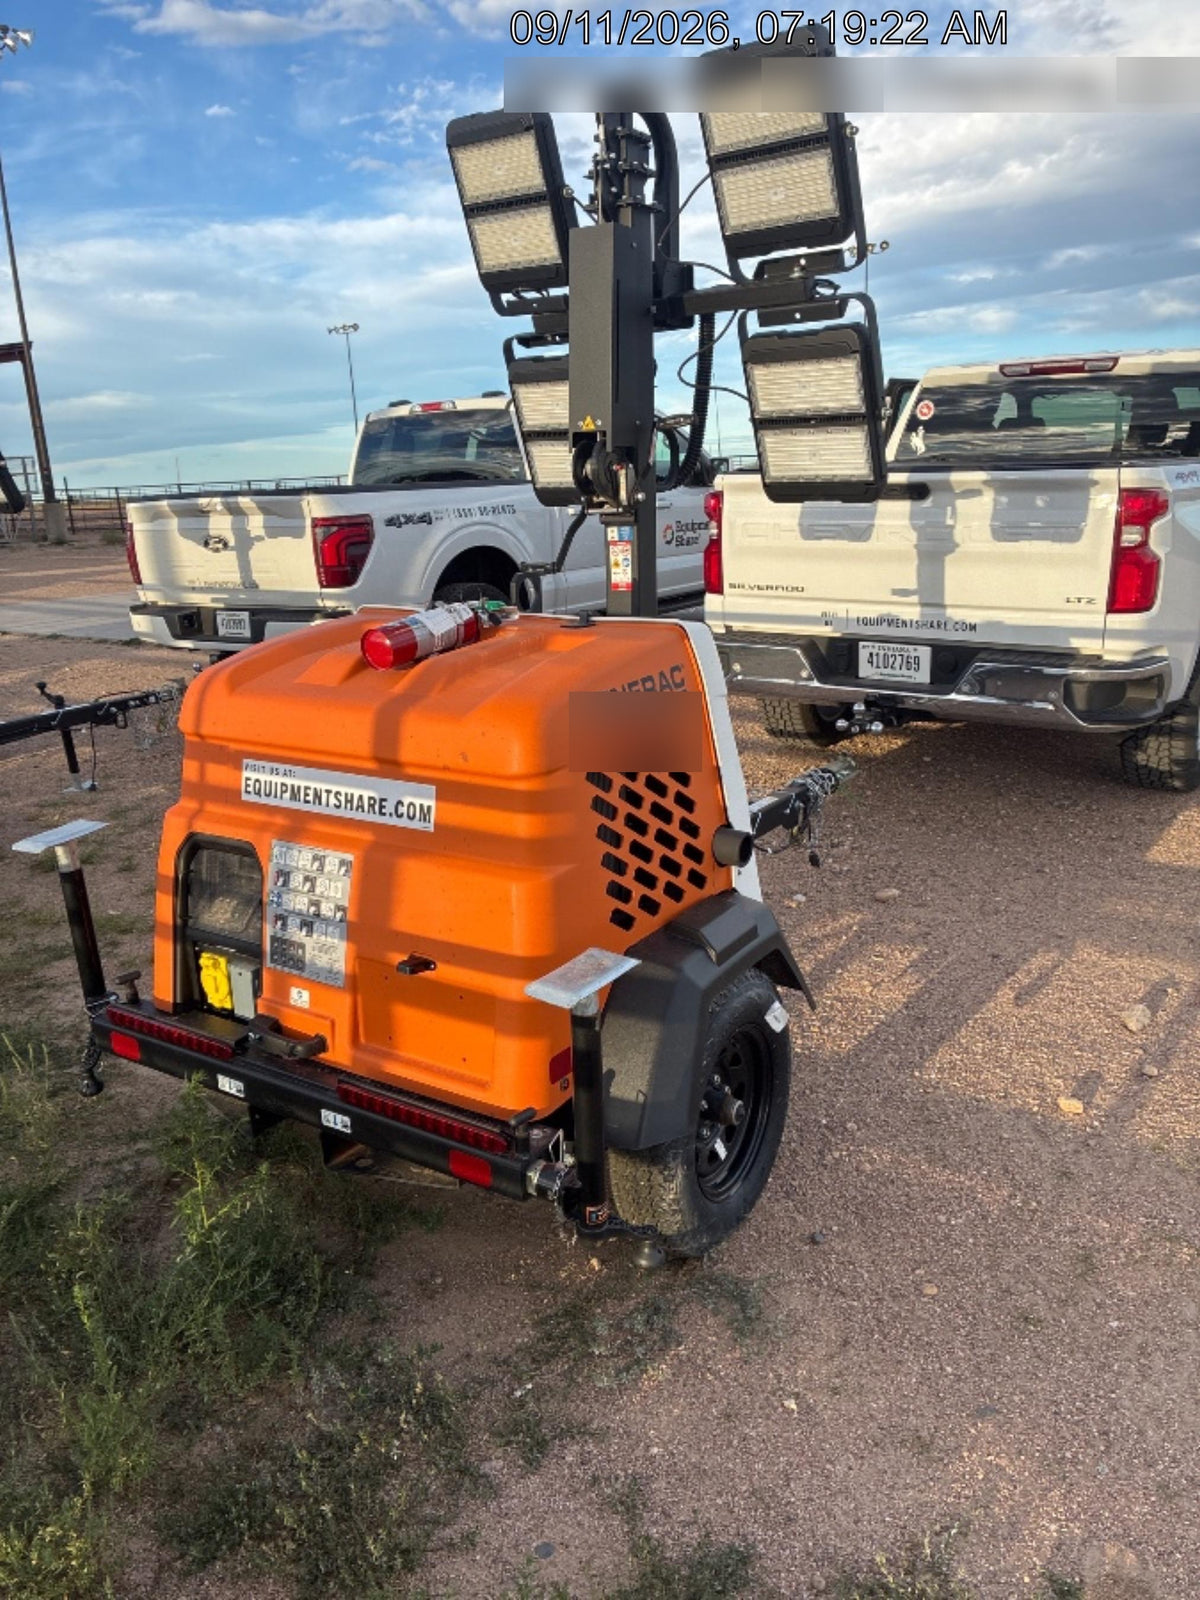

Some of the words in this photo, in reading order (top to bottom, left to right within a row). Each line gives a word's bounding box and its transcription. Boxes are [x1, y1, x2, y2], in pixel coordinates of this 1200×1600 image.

[728, 582, 805, 593] SILVERADO
[1065, 596, 1097, 605] LTZ
[856, 616, 977, 633] EQUIPMENTSHARE.COM
[244, 777, 433, 825] EQUIPMENTSHARE.COM
